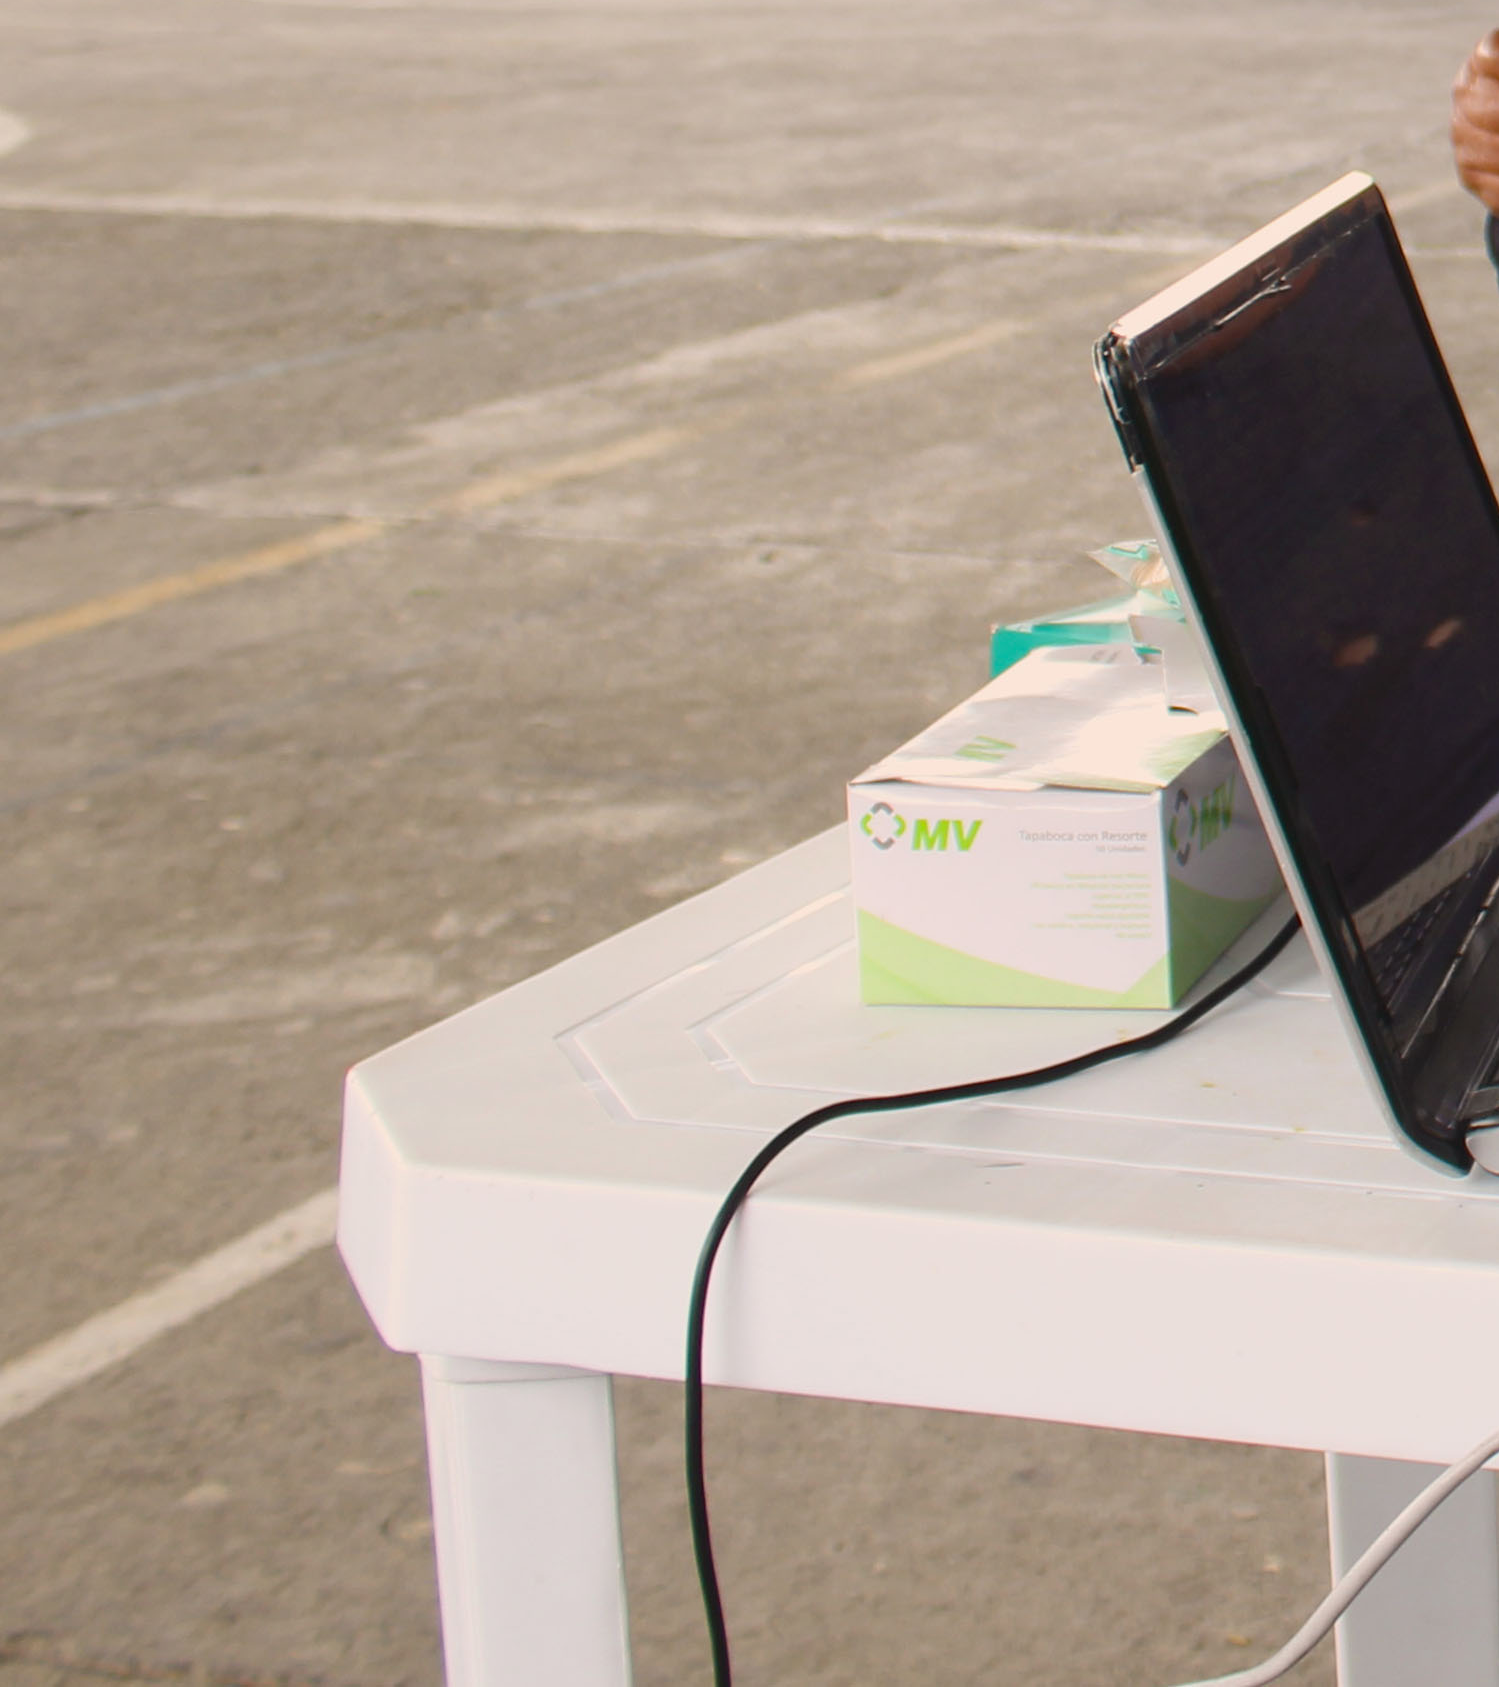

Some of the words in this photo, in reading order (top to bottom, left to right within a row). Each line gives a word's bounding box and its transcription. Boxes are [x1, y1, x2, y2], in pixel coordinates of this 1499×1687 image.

[911, 818, 983, 852] MV
[1018, 830, 1074, 843] Tapaboca
[1077, 832, 1099, 842] con
[1102, 830, 1148, 842] Resorte
